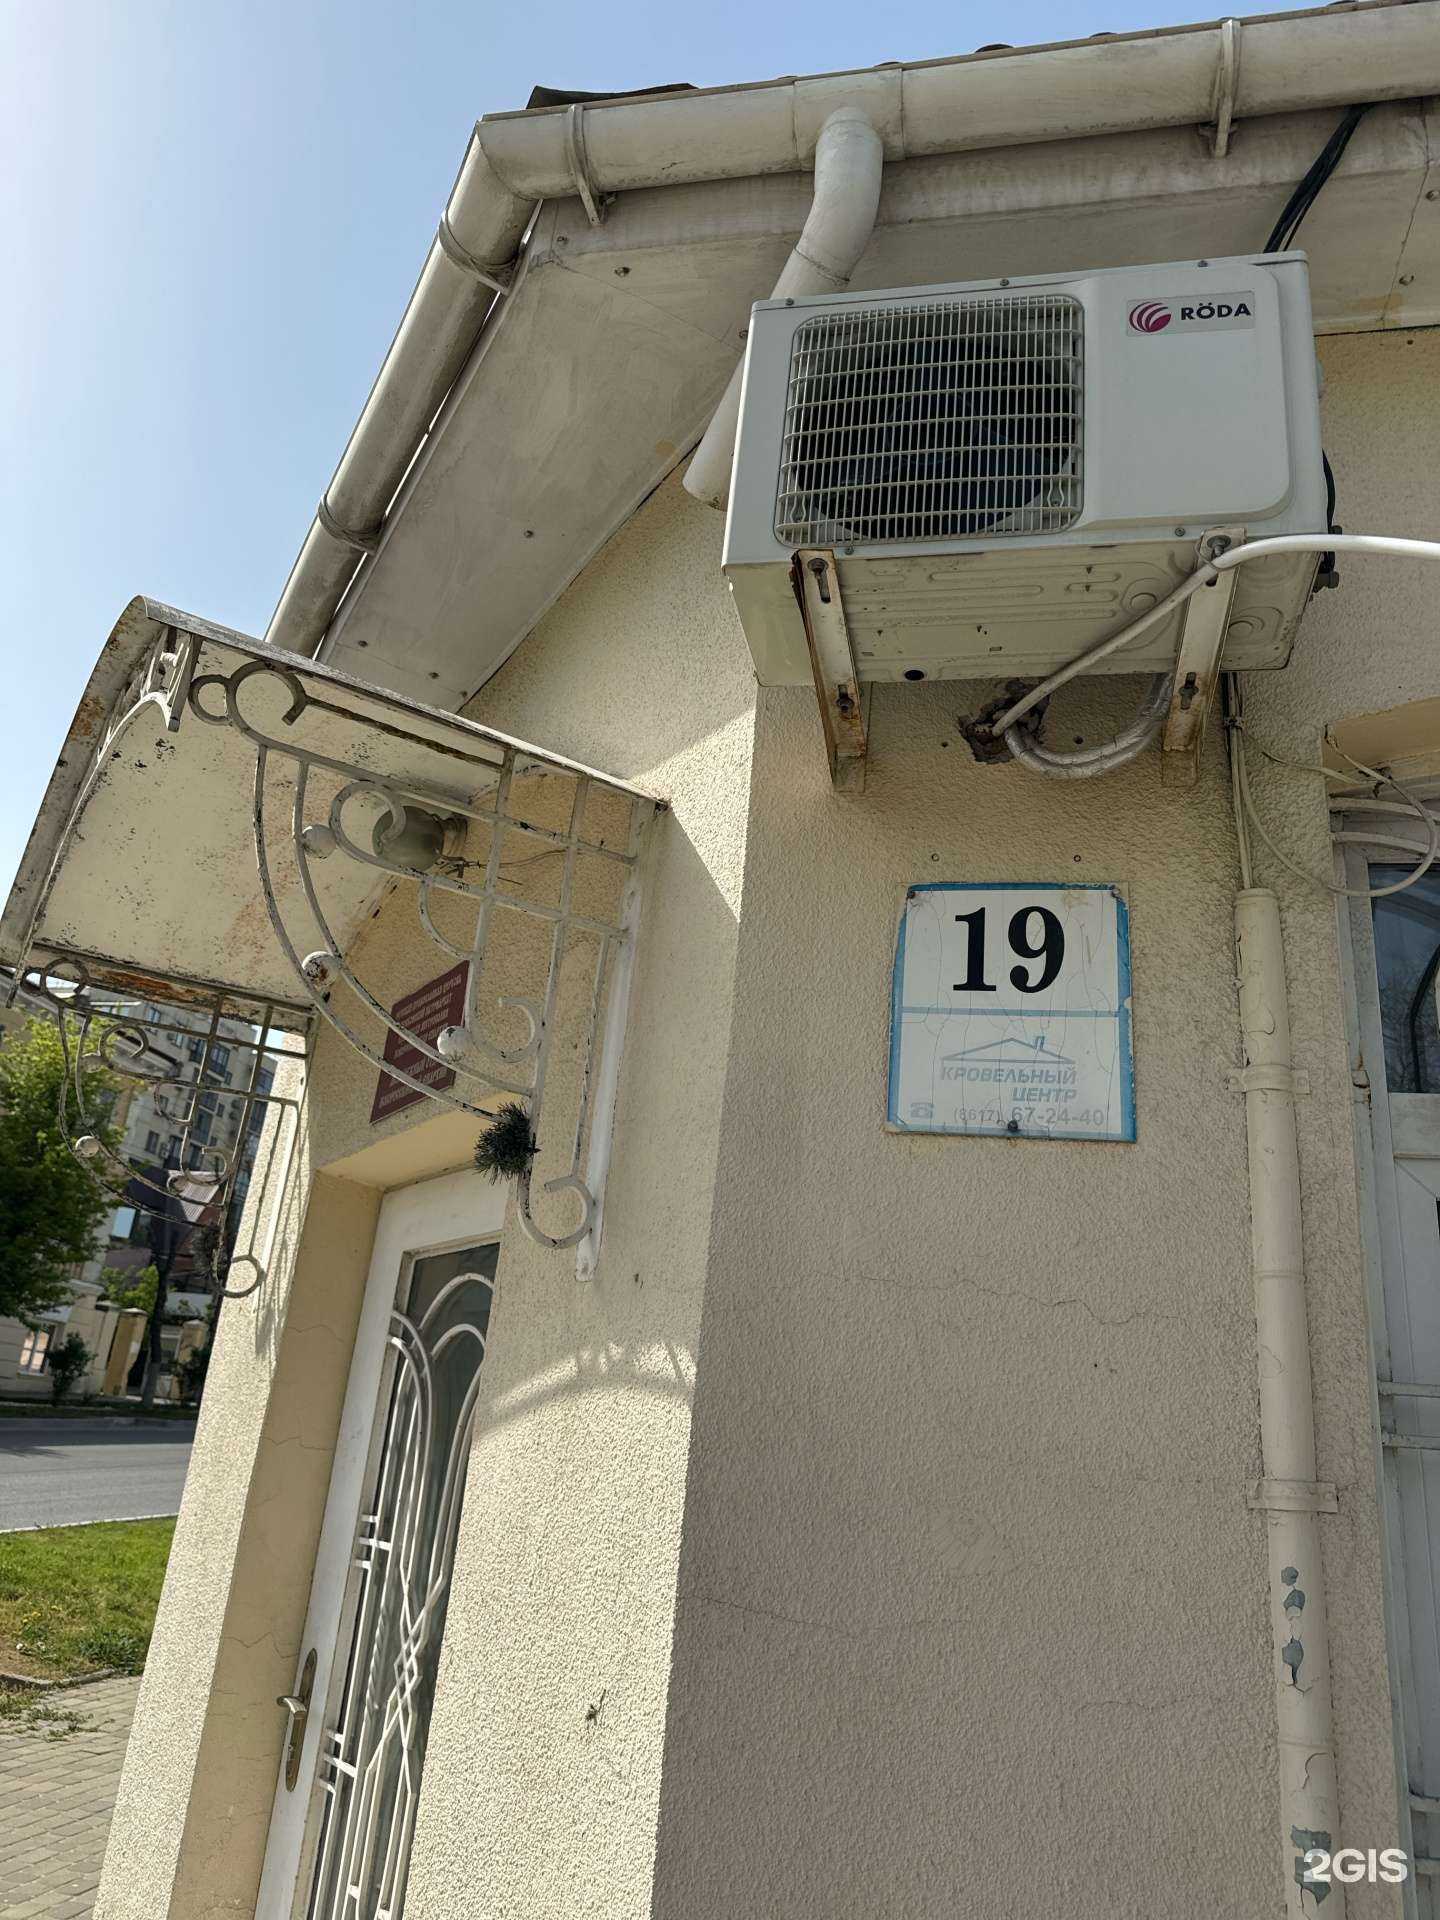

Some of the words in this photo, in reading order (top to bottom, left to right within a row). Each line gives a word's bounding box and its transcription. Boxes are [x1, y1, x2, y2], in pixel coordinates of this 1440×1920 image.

[1180, 302, 1251, 320] RÖDA
[953, 906, 1065, 993] 19
[940, 1066, 1077, 1085] КРОВЕЛЬНЫЙ
[1012, 1087, 1077, 1103] ЦЕНТР
[1011, 1106, 1105, 1126] 67-24-40
